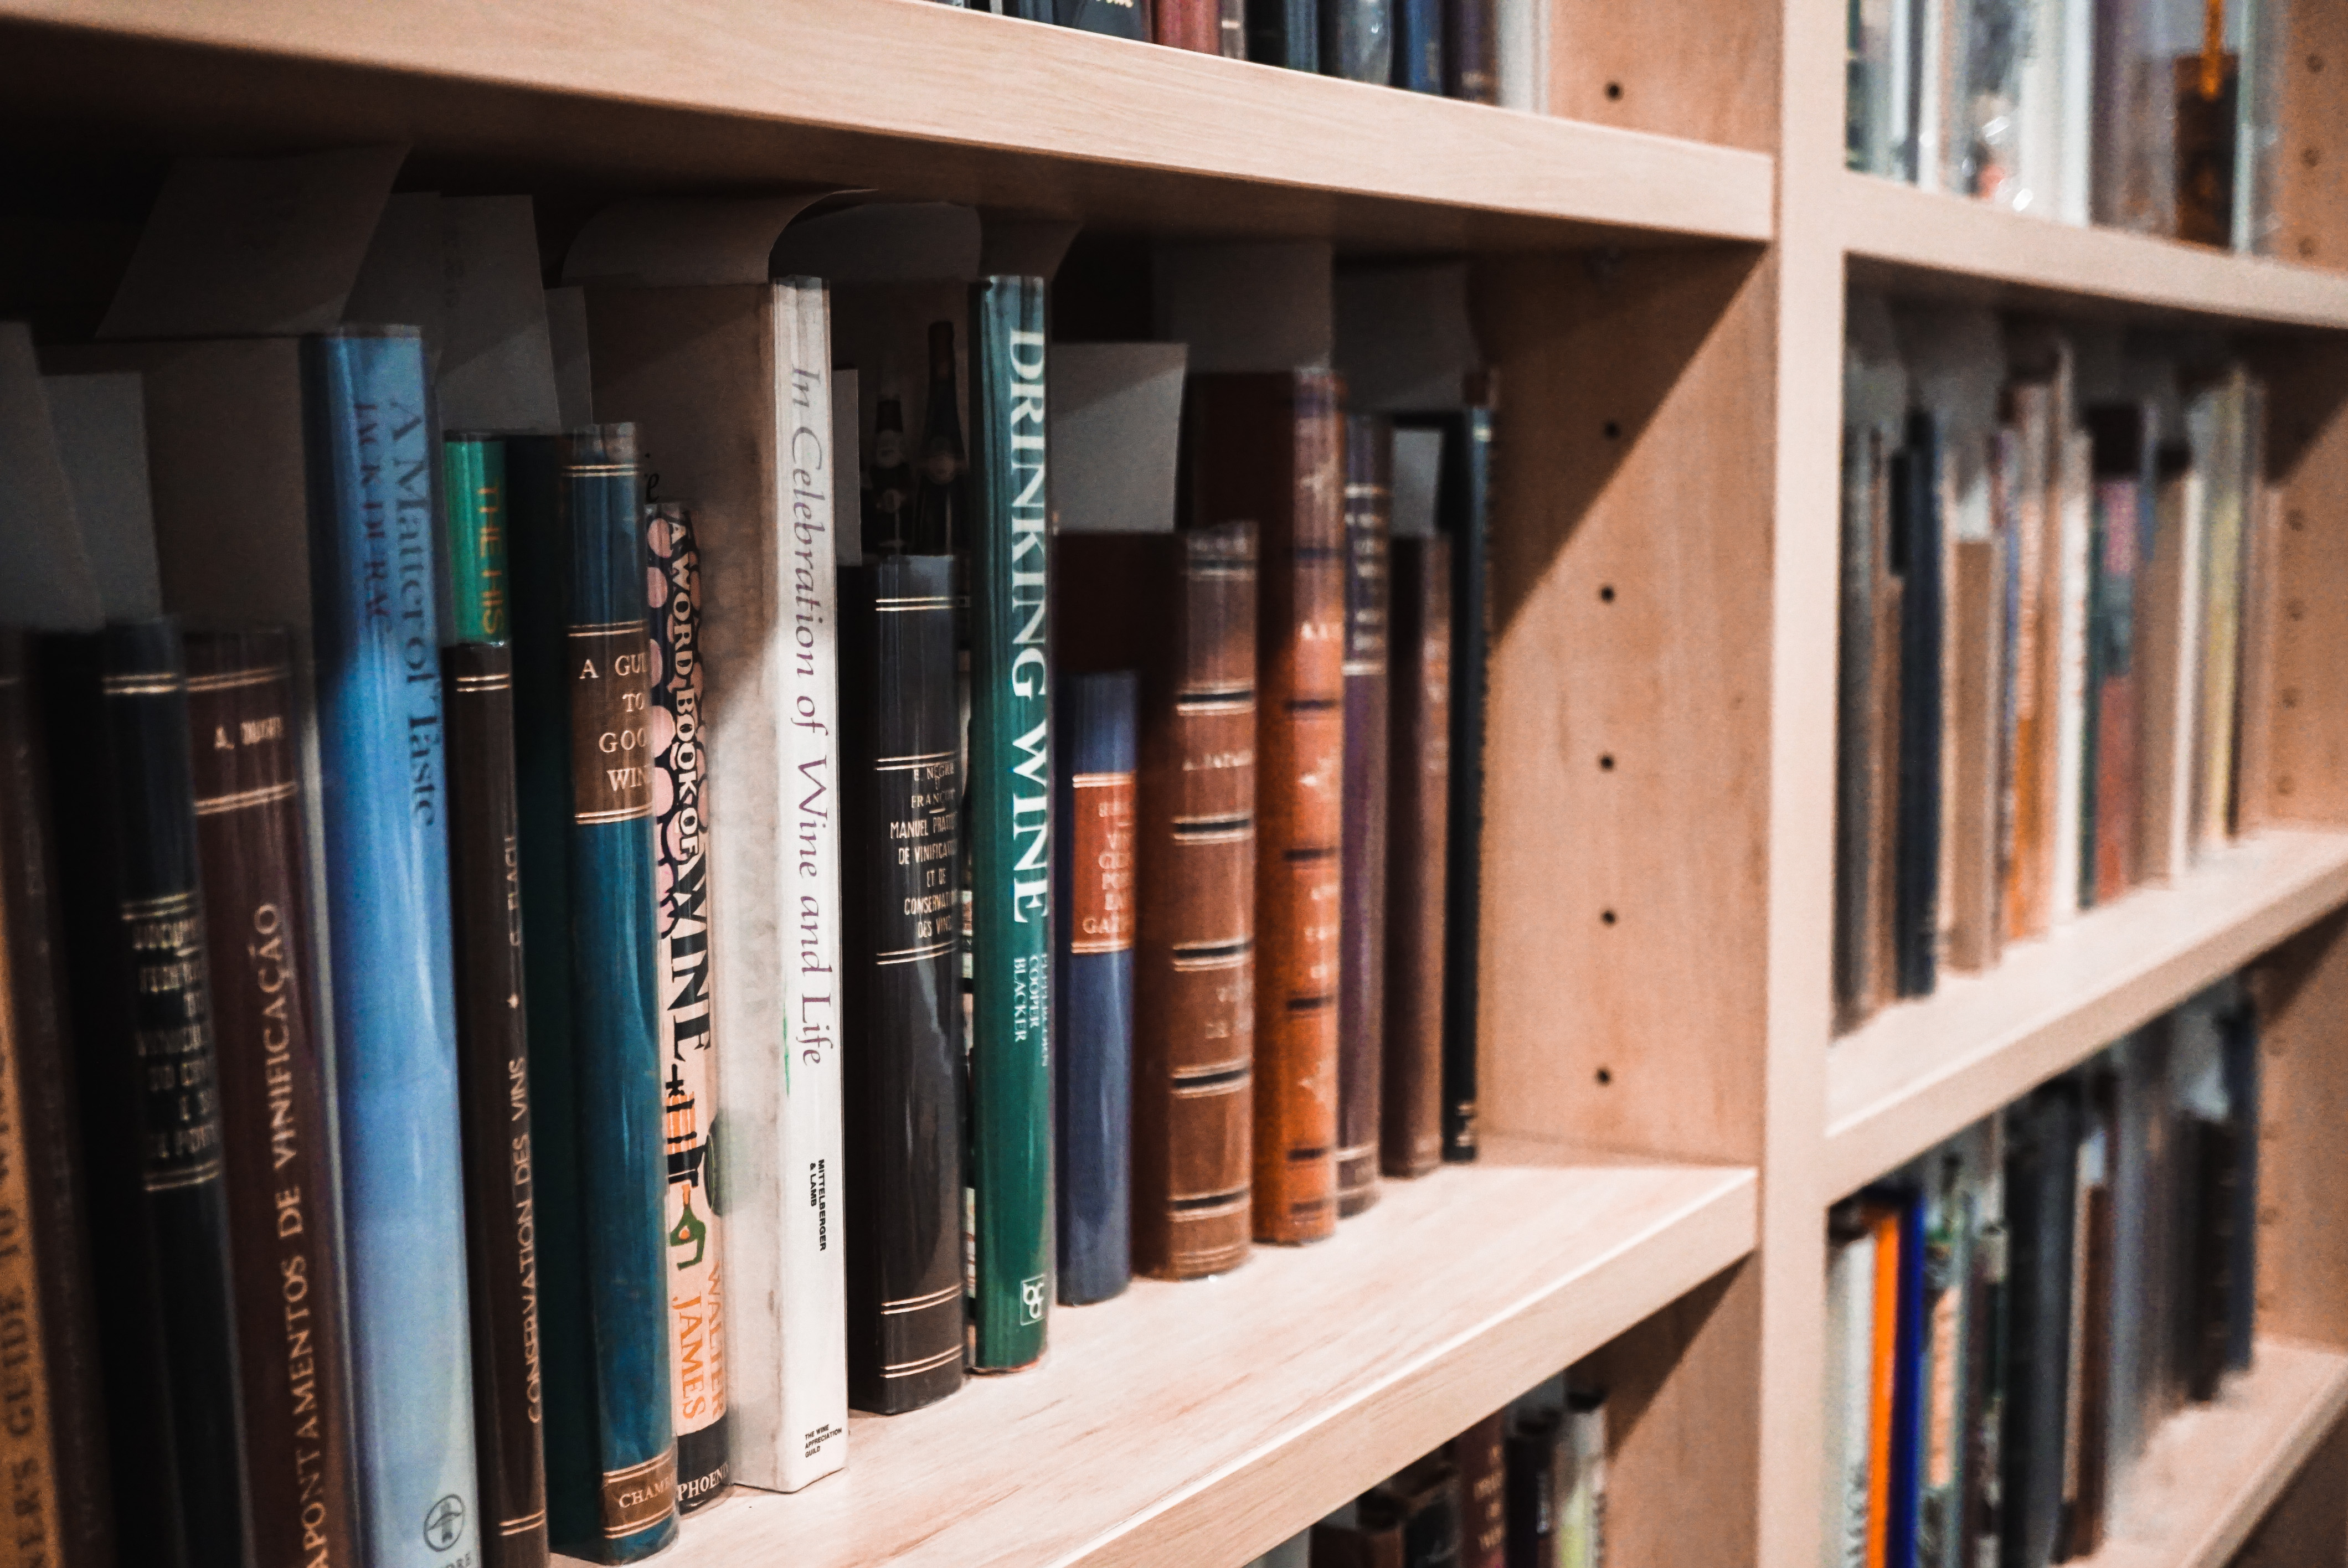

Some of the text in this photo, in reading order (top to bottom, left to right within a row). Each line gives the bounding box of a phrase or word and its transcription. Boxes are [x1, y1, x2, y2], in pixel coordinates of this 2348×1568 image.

[668, 520, 687, 546] A
[390, 400, 443, 827] A Matter of Taste
[1010, 329, 1047, 923] DRINKING WINE
[579, 652, 647, 679] A GUI
[622, 692, 645, 713] TO
[790, 363, 833, 1066] In Celebration of Wine and Life
[599, 728, 646, 754] GOO
[607, 765, 648, 792] WIN
[679, 807, 699, 856] OF
[890, 820, 928, 839] MANUEL
[898, 839, 957, 865] DE VINIFICAT
[918, 921, 932, 938] DES
[667, 844, 711, 1062] WINE
[1013, 958, 1027, 1043] BLACKER
[1029, 955, 1038, 1029] COOPER
[810, 1163, 816, 1171] &
[818, 1159, 826, 1251] MITTELBERGER
[249, 903, 331, 1568] APONTAMENTOS DE VINIFICAÇÃO
[508, 1056, 542, 1423] CONSERVATION DES VINS
[672, 1290, 707, 1419] JAMES
[708, 1261, 723, 1421] WALTER
[805, 1423, 830, 1440] THE WINE
[805, 1427, 842, 1449] APPRECIATION
[805, 1446, 821, 1458] GUILD
[619, 1477, 670, 1508] CHAM
